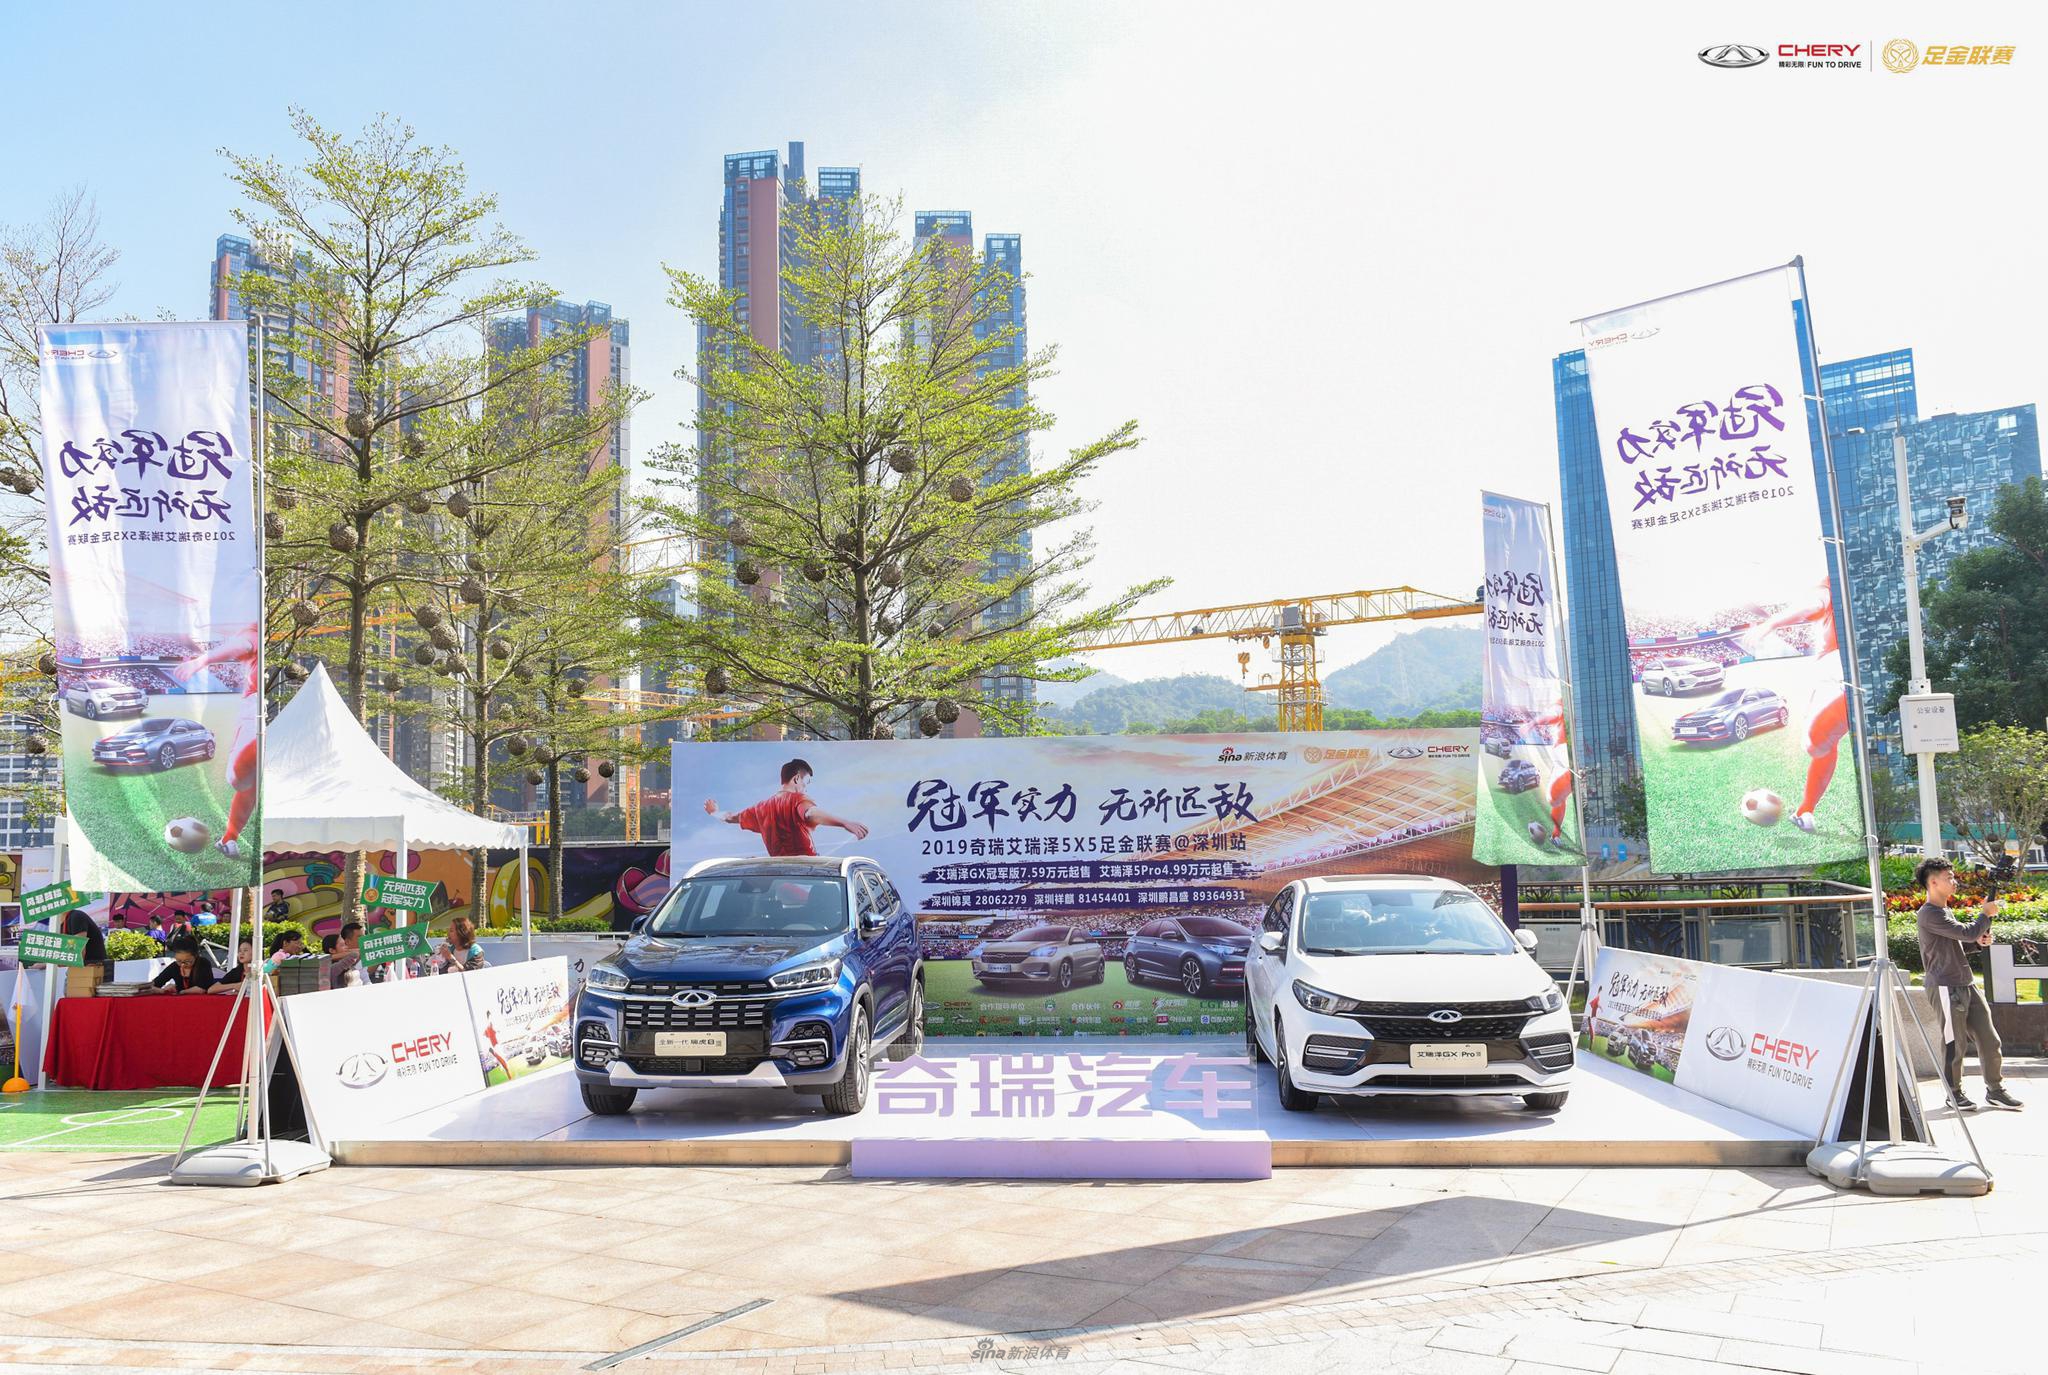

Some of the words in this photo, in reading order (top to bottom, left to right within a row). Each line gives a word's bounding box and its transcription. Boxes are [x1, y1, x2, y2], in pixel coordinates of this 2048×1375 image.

[1243, 751, 1288, 761] 新浪体育
[1427, 745, 1470, 753] CHERY
[907, 779, 1077, 833] 冠军实力
[1099, 782, 1260, 826] 无所匹敌
[922, 833, 1246, 857] 2019奇瑞艾瑞泽5X5足金联赛@深圳站
[935, 865, 1091, 881] 艾瑞泽GX冠军版7.59万元起售
[1099, 862, 1233, 878] 艾瑞泽5Pro4.99万元起售
[383, 880, 427, 896] 无所匹敌
[381, 892, 425, 909] 冠军实力
[975, 894, 1027, 906] 28062279
[1078, 892, 1130, 904] 81454401
[1193, 890, 1246, 902] 89364931
[391, 1031, 451, 1063] CHERY
[1751, 1033, 1820, 1069] CHERY
[418, 1060, 431, 1073] FUN
[431, 1057, 441, 1069] TO
[874, 1052, 1251, 1119] 奇瑞汽车
[1767, 1065, 1782, 1079] FUN
[1782, 1069, 1792, 1083] TO
[1791, 1072, 1814, 1090] DRIVE
